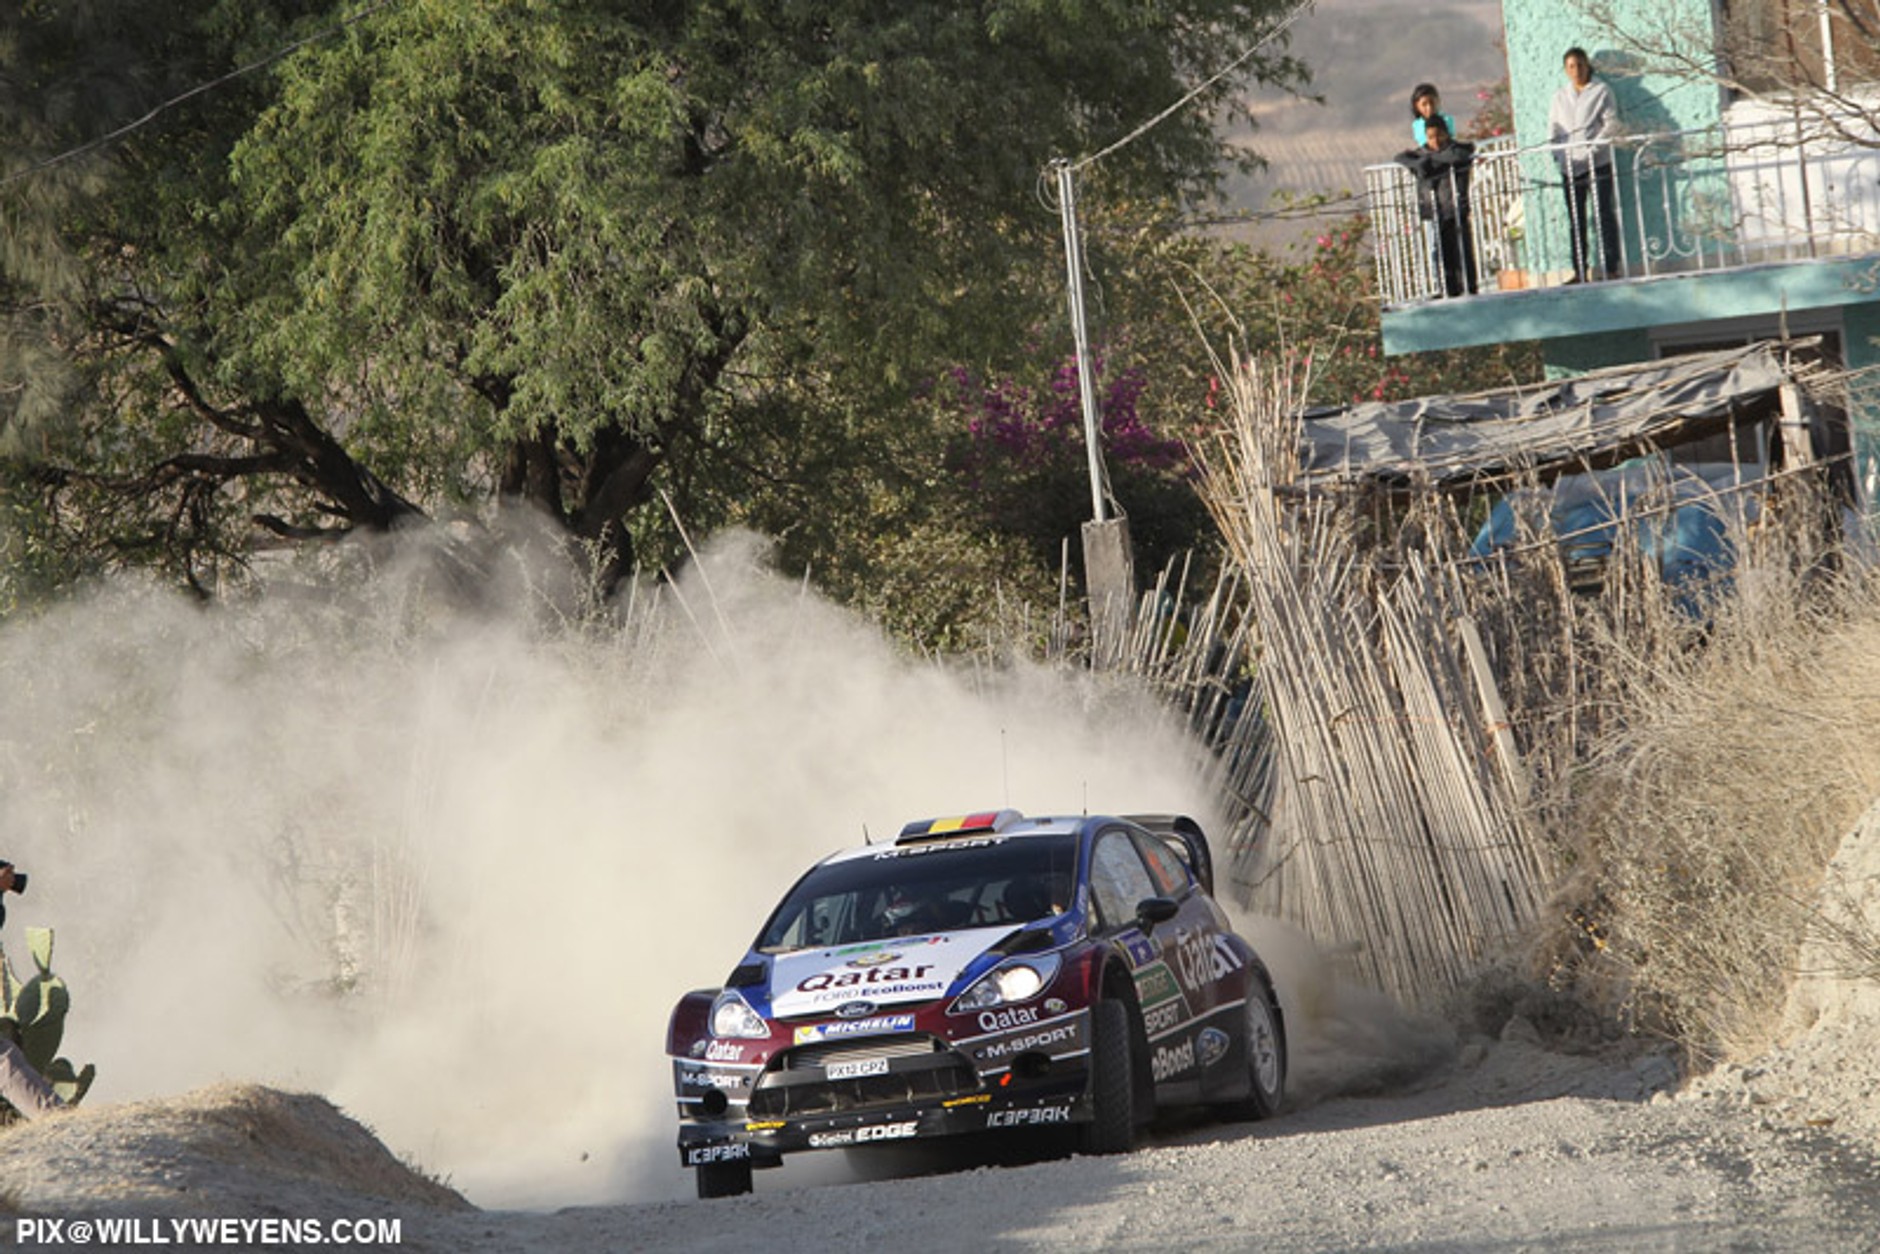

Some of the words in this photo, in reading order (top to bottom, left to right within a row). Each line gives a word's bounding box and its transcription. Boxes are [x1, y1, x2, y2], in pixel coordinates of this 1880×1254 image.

[797, 965, 935, 992] Qatar
[861, 982, 944, 996] EcoBoost
[825, 1016, 912, 1035] MICHELIN
[978, 1006, 1038, 1032] Qatar
[705, 1040, 743, 1060] Qatar
[986, 1024, 1076, 1058] M-SPORT
[856, 1121, 918, 1142] EDGE
